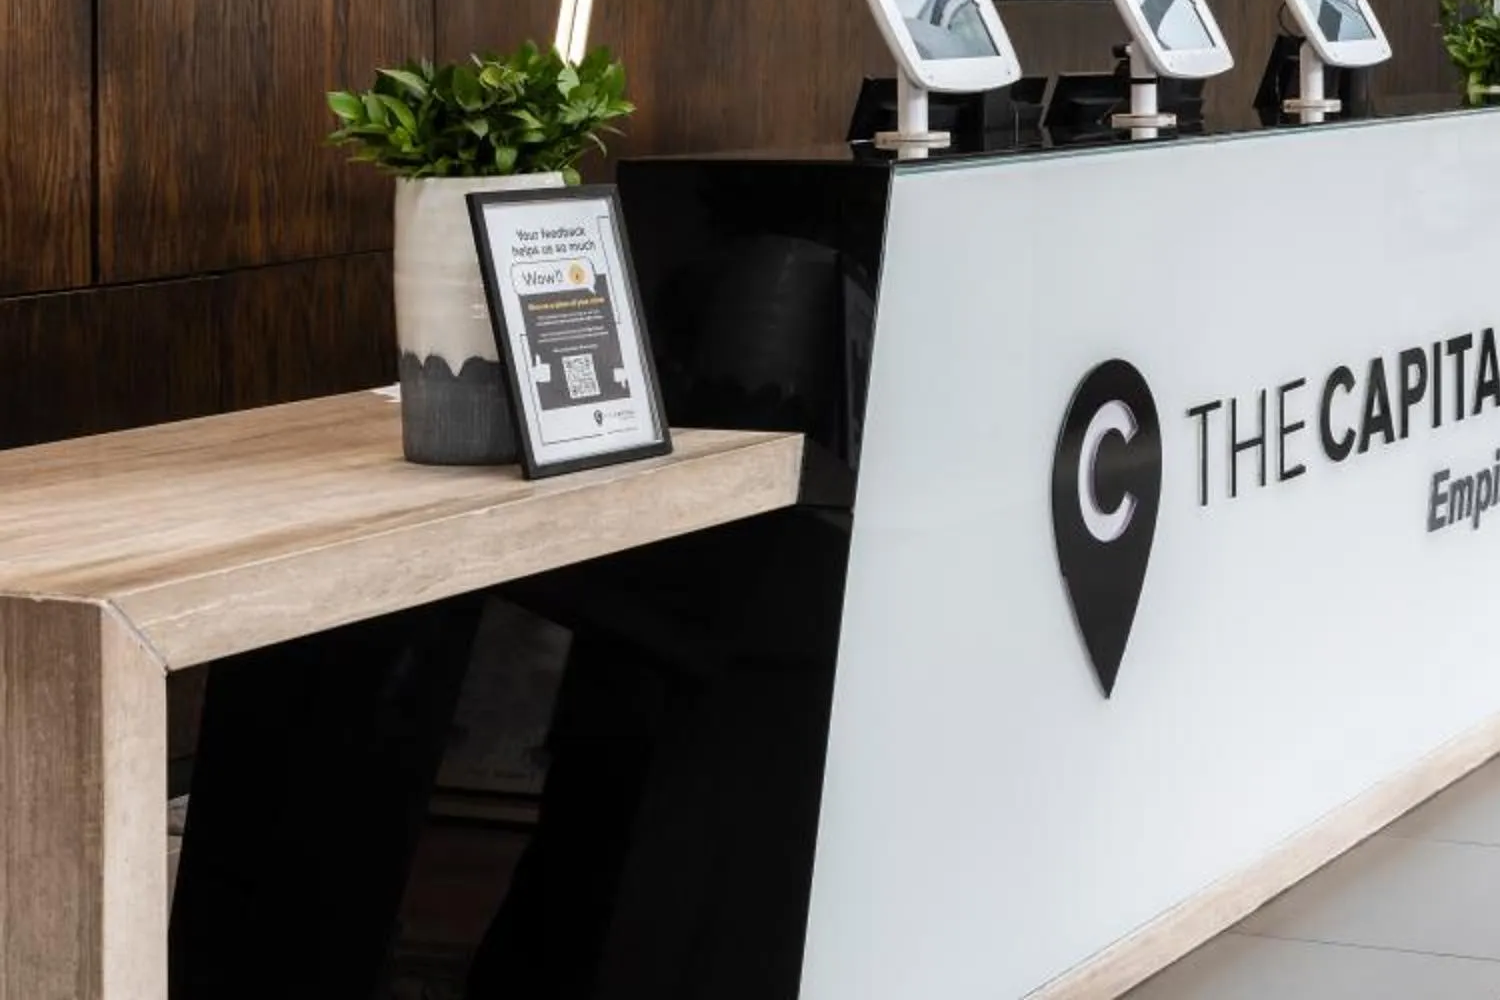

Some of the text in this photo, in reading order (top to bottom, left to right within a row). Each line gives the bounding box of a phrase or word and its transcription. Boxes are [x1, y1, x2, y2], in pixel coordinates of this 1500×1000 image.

[515, 226, 585, 241] Your feedback
[511, 245, 540, 258] helps
[568, 240, 596, 251] much
[1187, 377, 1306, 506] THE
